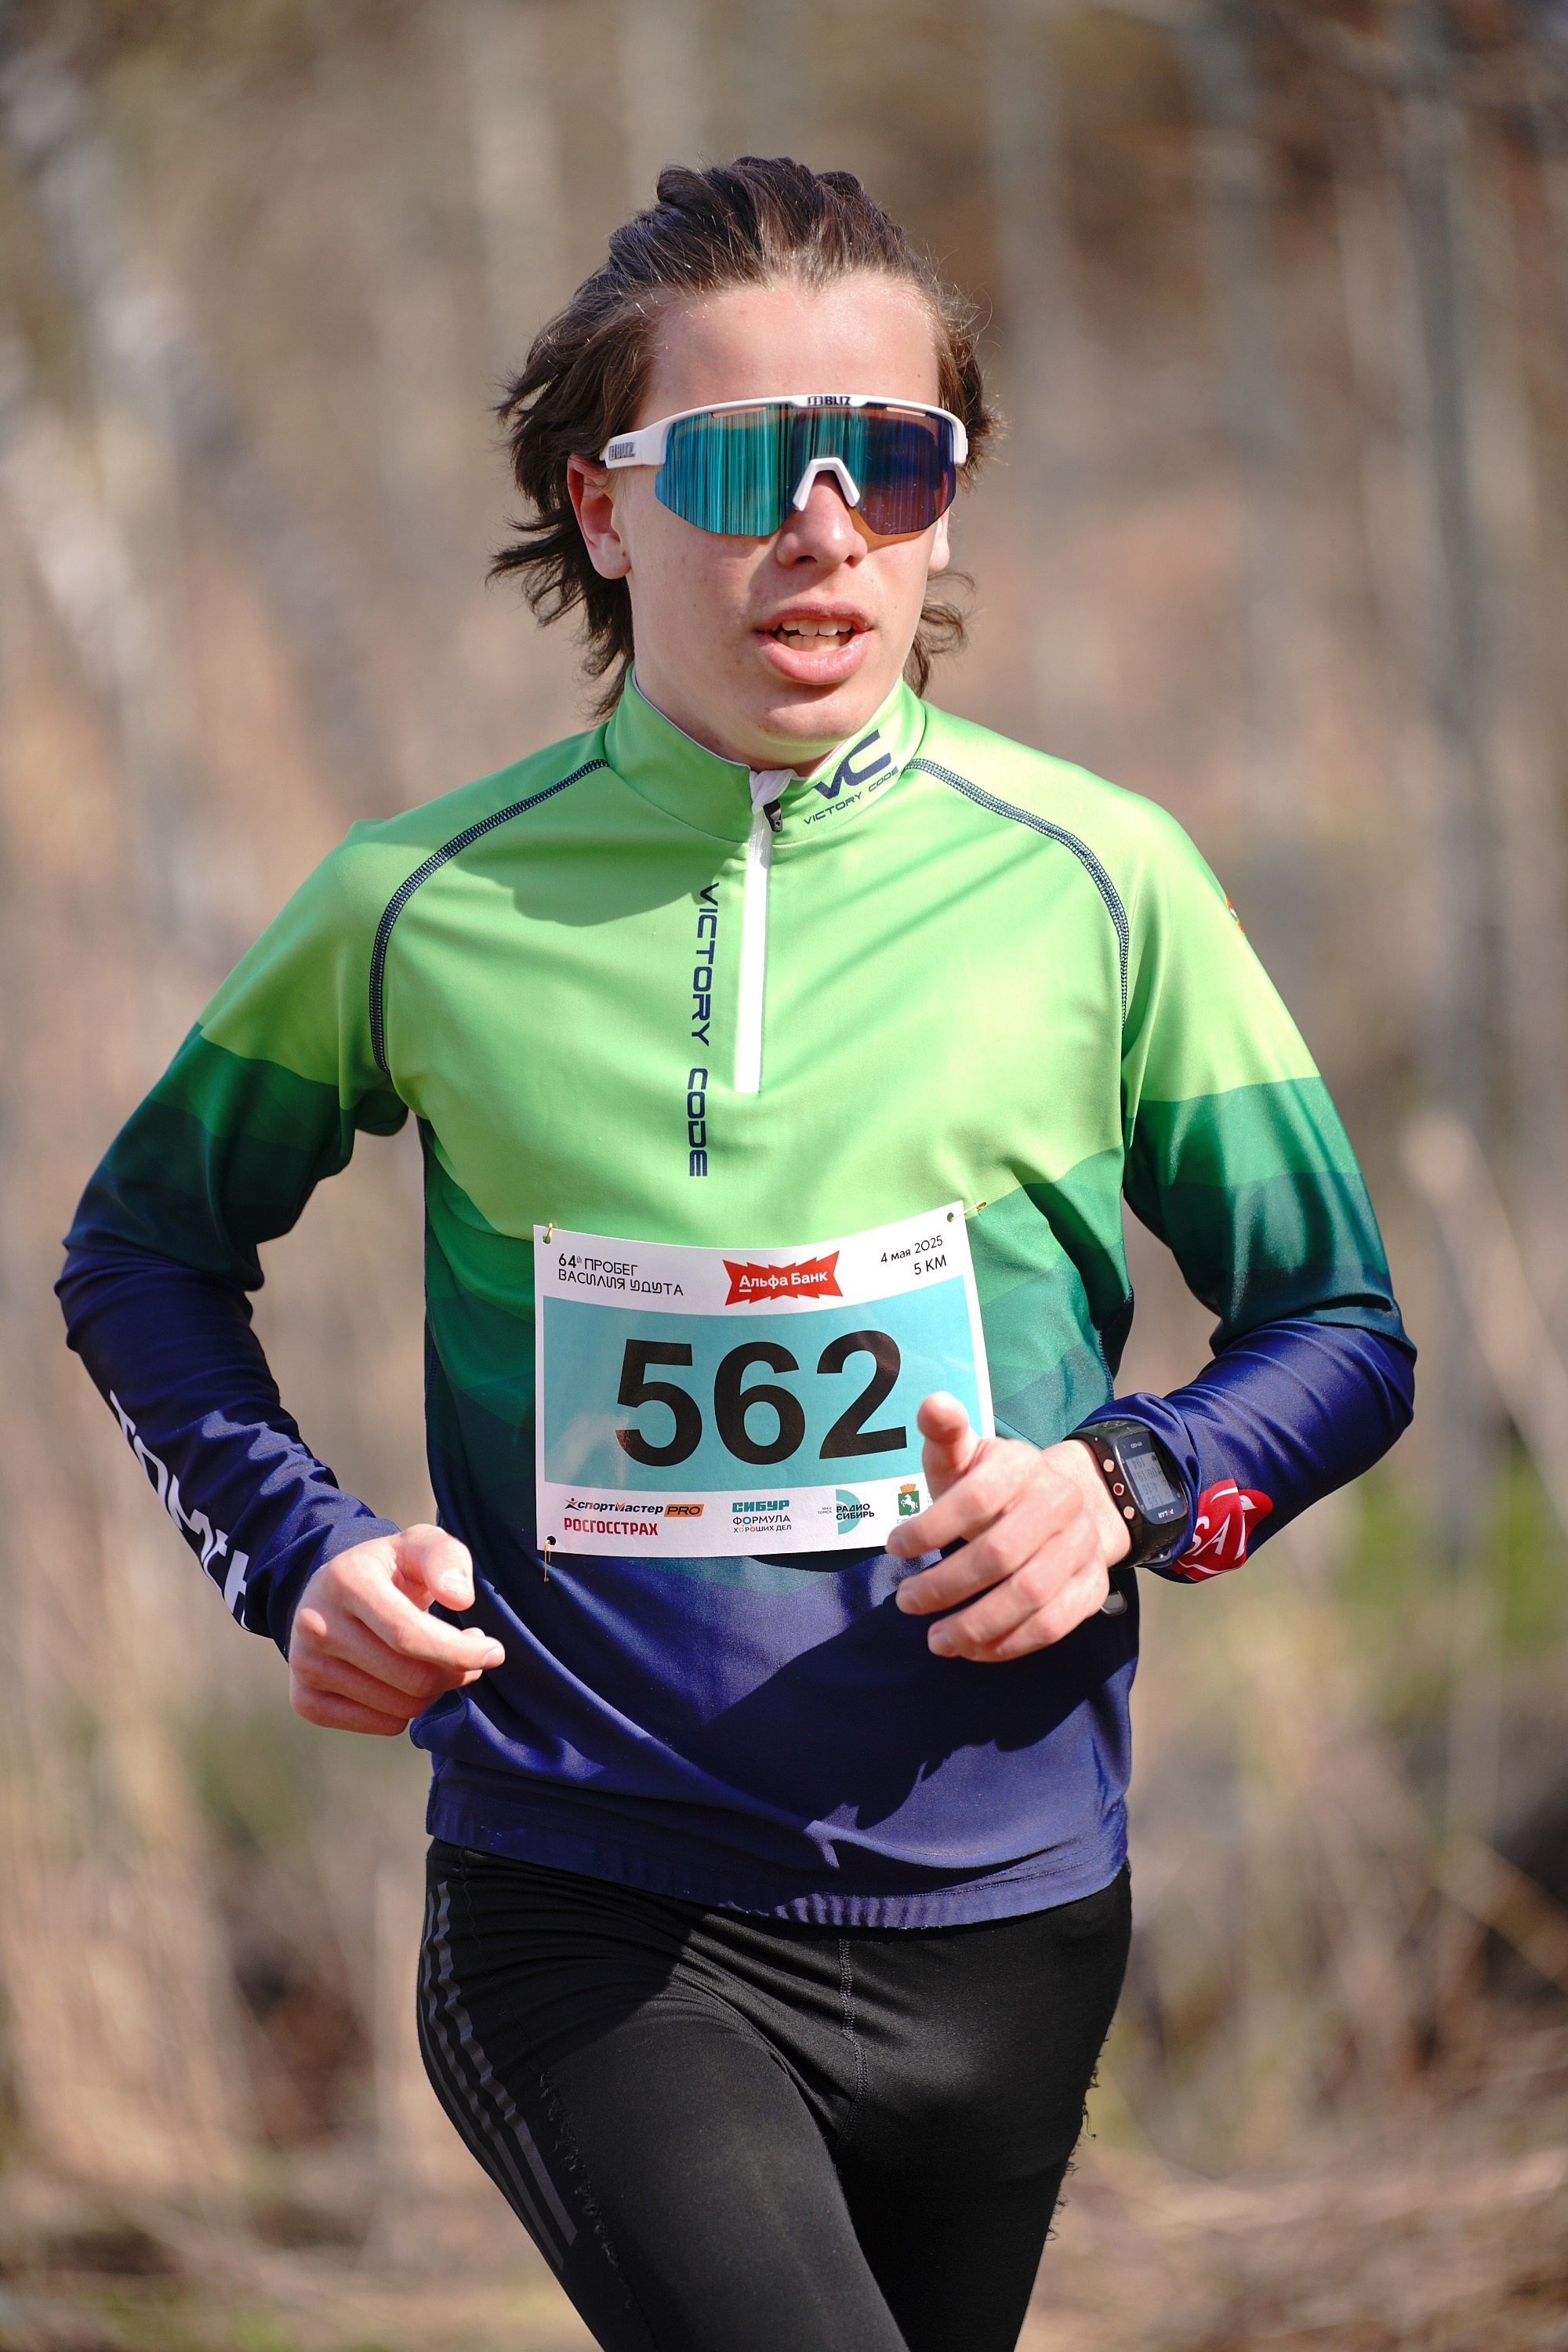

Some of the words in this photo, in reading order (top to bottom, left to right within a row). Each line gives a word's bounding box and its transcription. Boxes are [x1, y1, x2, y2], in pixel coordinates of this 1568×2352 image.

[814, 728, 891, 800] VC
[804, 791, 862, 824] VICTORY
[869, 766, 898, 792] CODE
[691, 883, 720, 1046] VICTORY
[688, 1068, 709, 1177] CODE
[880, 1252, 887, 1263] 4
[891, 1249, 911, 1261] мая
[914, 1235, 943, 1254] 2025
[584, 1258, 638, 1276] ПРОБЕГ
[914, 1262, 922, 1276] 5
[925, 1254, 947, 1272] КМ
[558, 1269, 626, 1290] ВАСИЛИЯ
[739, 1274, 789, 1291] Альфа
[791, 1271, 829, 1286] Банк
[615, 1330, 908, 1468] 562
[666, 1505, 702, 1515] PRO
[731, 1500, 789, 1513] СИБУР
[836, 1503, 870, 1513] РАДИО
[836, 1512, 875, 1520] СИБИРЬ
[564, 1517, 659, 1536] РОСГОССТРАХ
[732, 1515, 791, 1526] ФОРМУЛА
[733, 1524, 775, 1534] ХОРОШИХ
